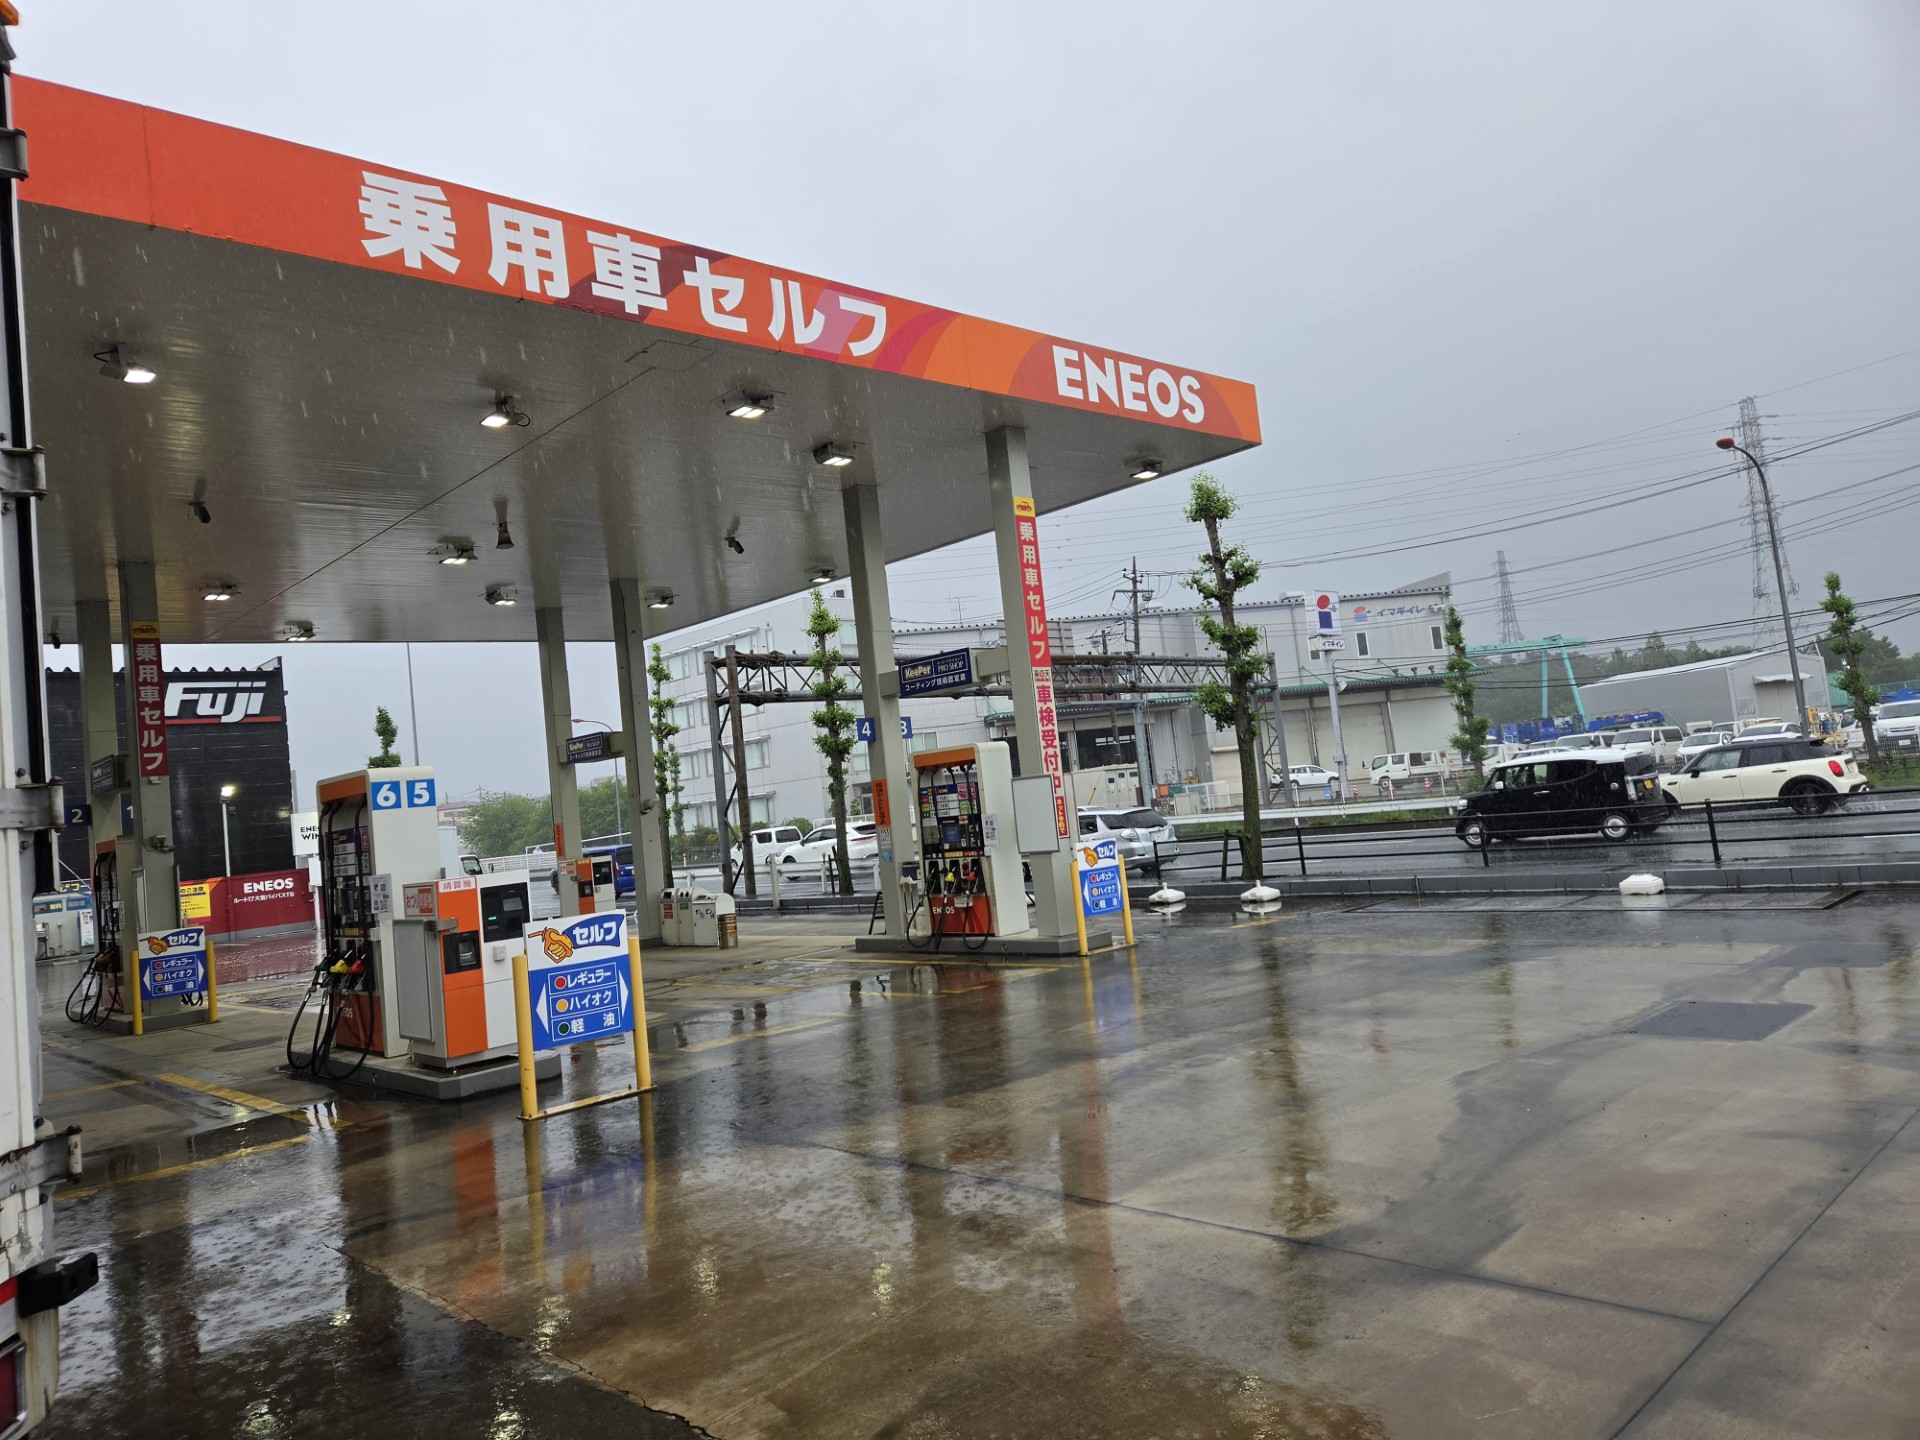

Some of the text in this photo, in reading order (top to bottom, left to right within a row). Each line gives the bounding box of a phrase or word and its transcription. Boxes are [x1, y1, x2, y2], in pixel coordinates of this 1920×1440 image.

[357, 169, 887, 357] 乗用車セルフ
[1052, 344, 1205, 424] ENEOS
[1019, 521, 1046, 660] 乗用車セルフ
[904, 665, 931, 679] KeePer
[135, 643, 164, 770] 乗用車セルフ
[861, 721, 872, 737] 4
[376, 781, 430, 807] 6 5
[71, 808, 83, 823] 2
[126, 805, 134, 819] 1
[300, 825, 319, 833] ENE
[1096, 844, 1114, 858] セルフ
[243, 877, 294, 894] ENEOS
[932, 906, 955, 914] ENOS
[167, 932, 198, 945] セルフ
[572, 920, 618, 944] セルフ
[163, 958, 193, 968] レギュラー
[163, 969, 193, 980] ハイオク
[567, 969, 612, 989] レギュラー
[569, 991, 612, 1011] ハイオク
